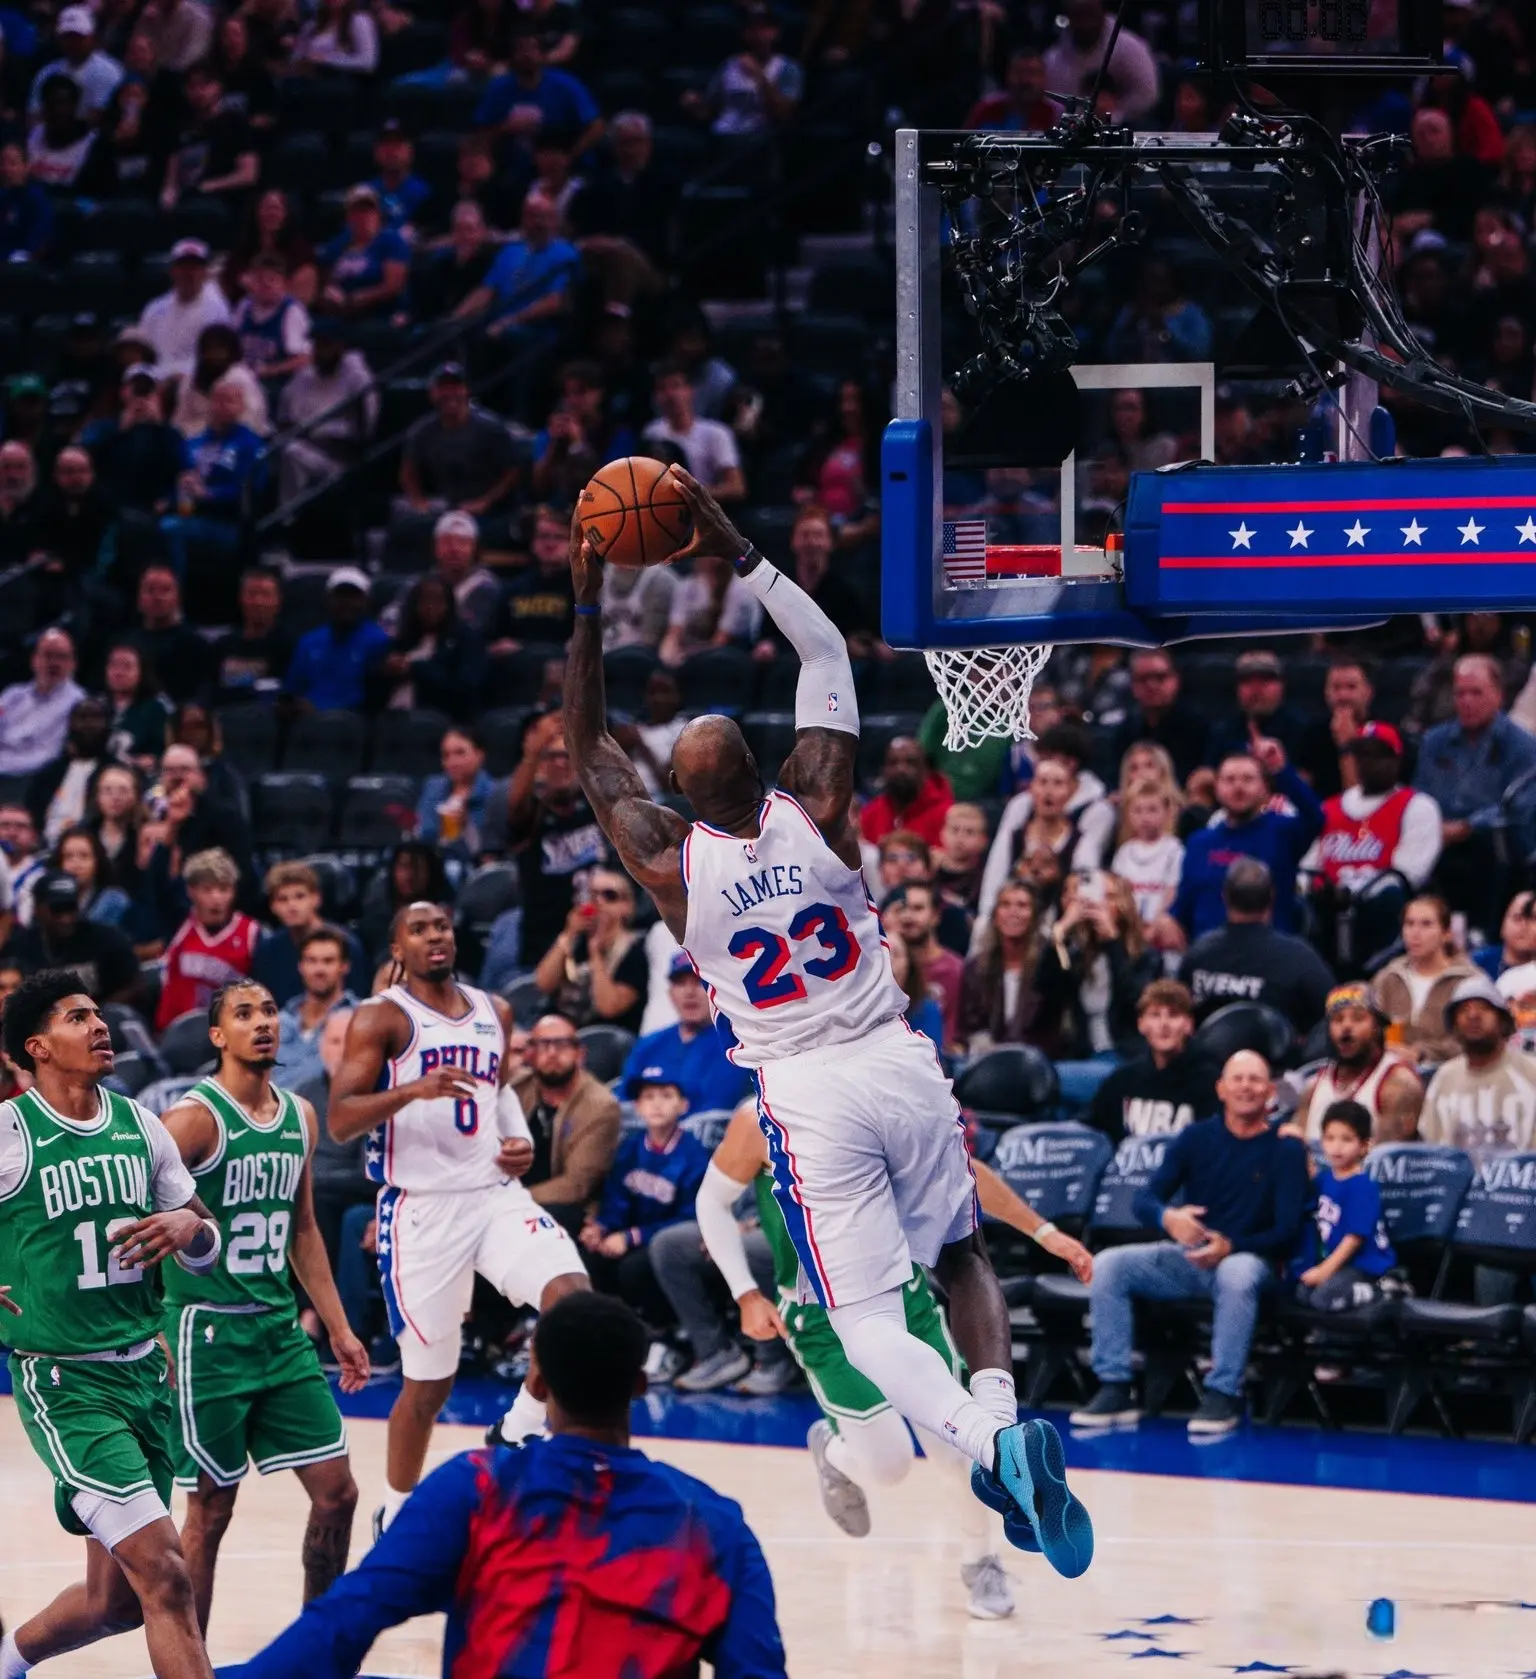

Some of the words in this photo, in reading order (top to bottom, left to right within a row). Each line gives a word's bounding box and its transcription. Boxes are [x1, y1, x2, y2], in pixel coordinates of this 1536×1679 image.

[721, 865, 803, 917] JAMES
[728, 902, 861, 1010] 23
[1192, 969, 1265, 999] EVENT
[111, 1131, 142, 1141] Amica
[455, 1098, 478, 1136] 0
[40, 1154, 148, 1219] BOSTON
[227, 1211, 290, 1274] 29
